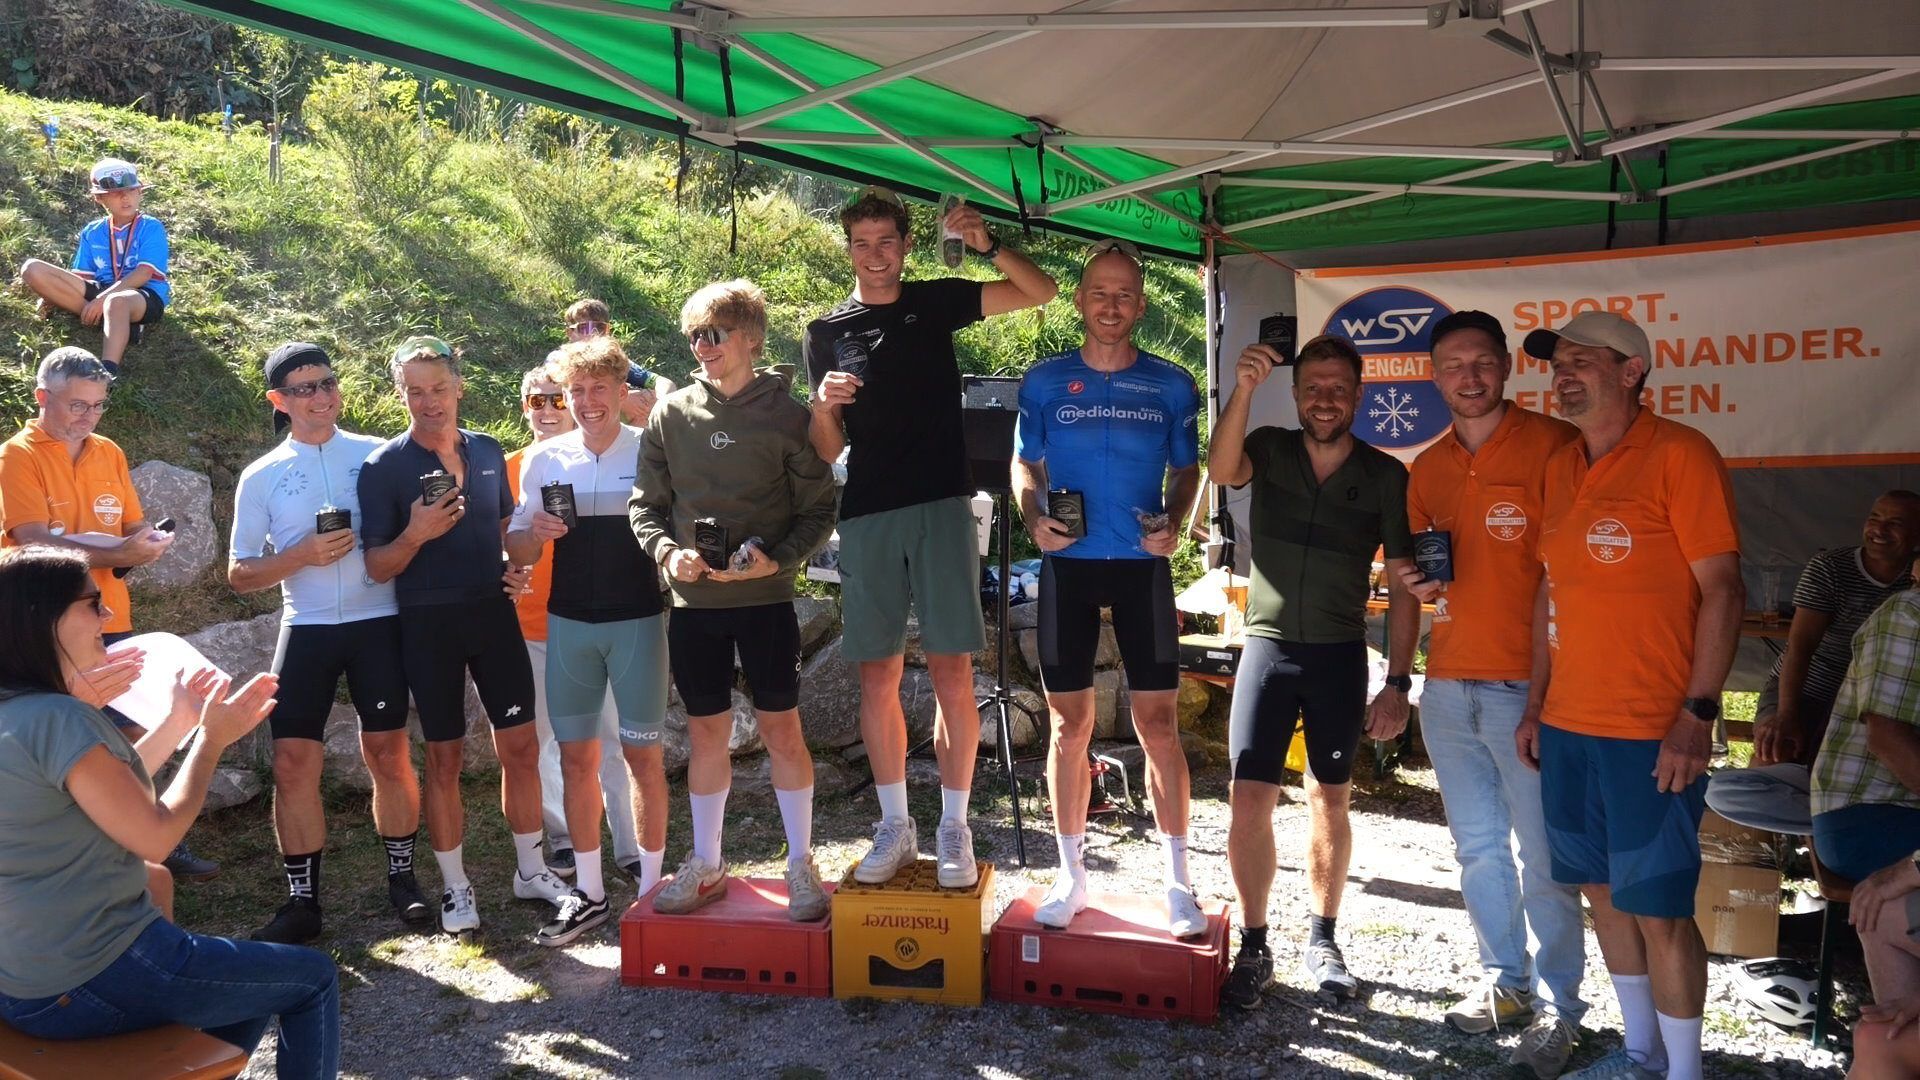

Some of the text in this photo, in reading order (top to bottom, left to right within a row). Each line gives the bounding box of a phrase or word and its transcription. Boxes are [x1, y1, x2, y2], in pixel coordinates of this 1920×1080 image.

[1341, 307, 1434, 346] WSV
[1515, 327, 1881, 376] MNANDER.
[1057, 405, 1163, 424] mediolanum
[1515, 383, 1737, 416] ERBEN.
[861, 913, 951, 936] frastanzer
